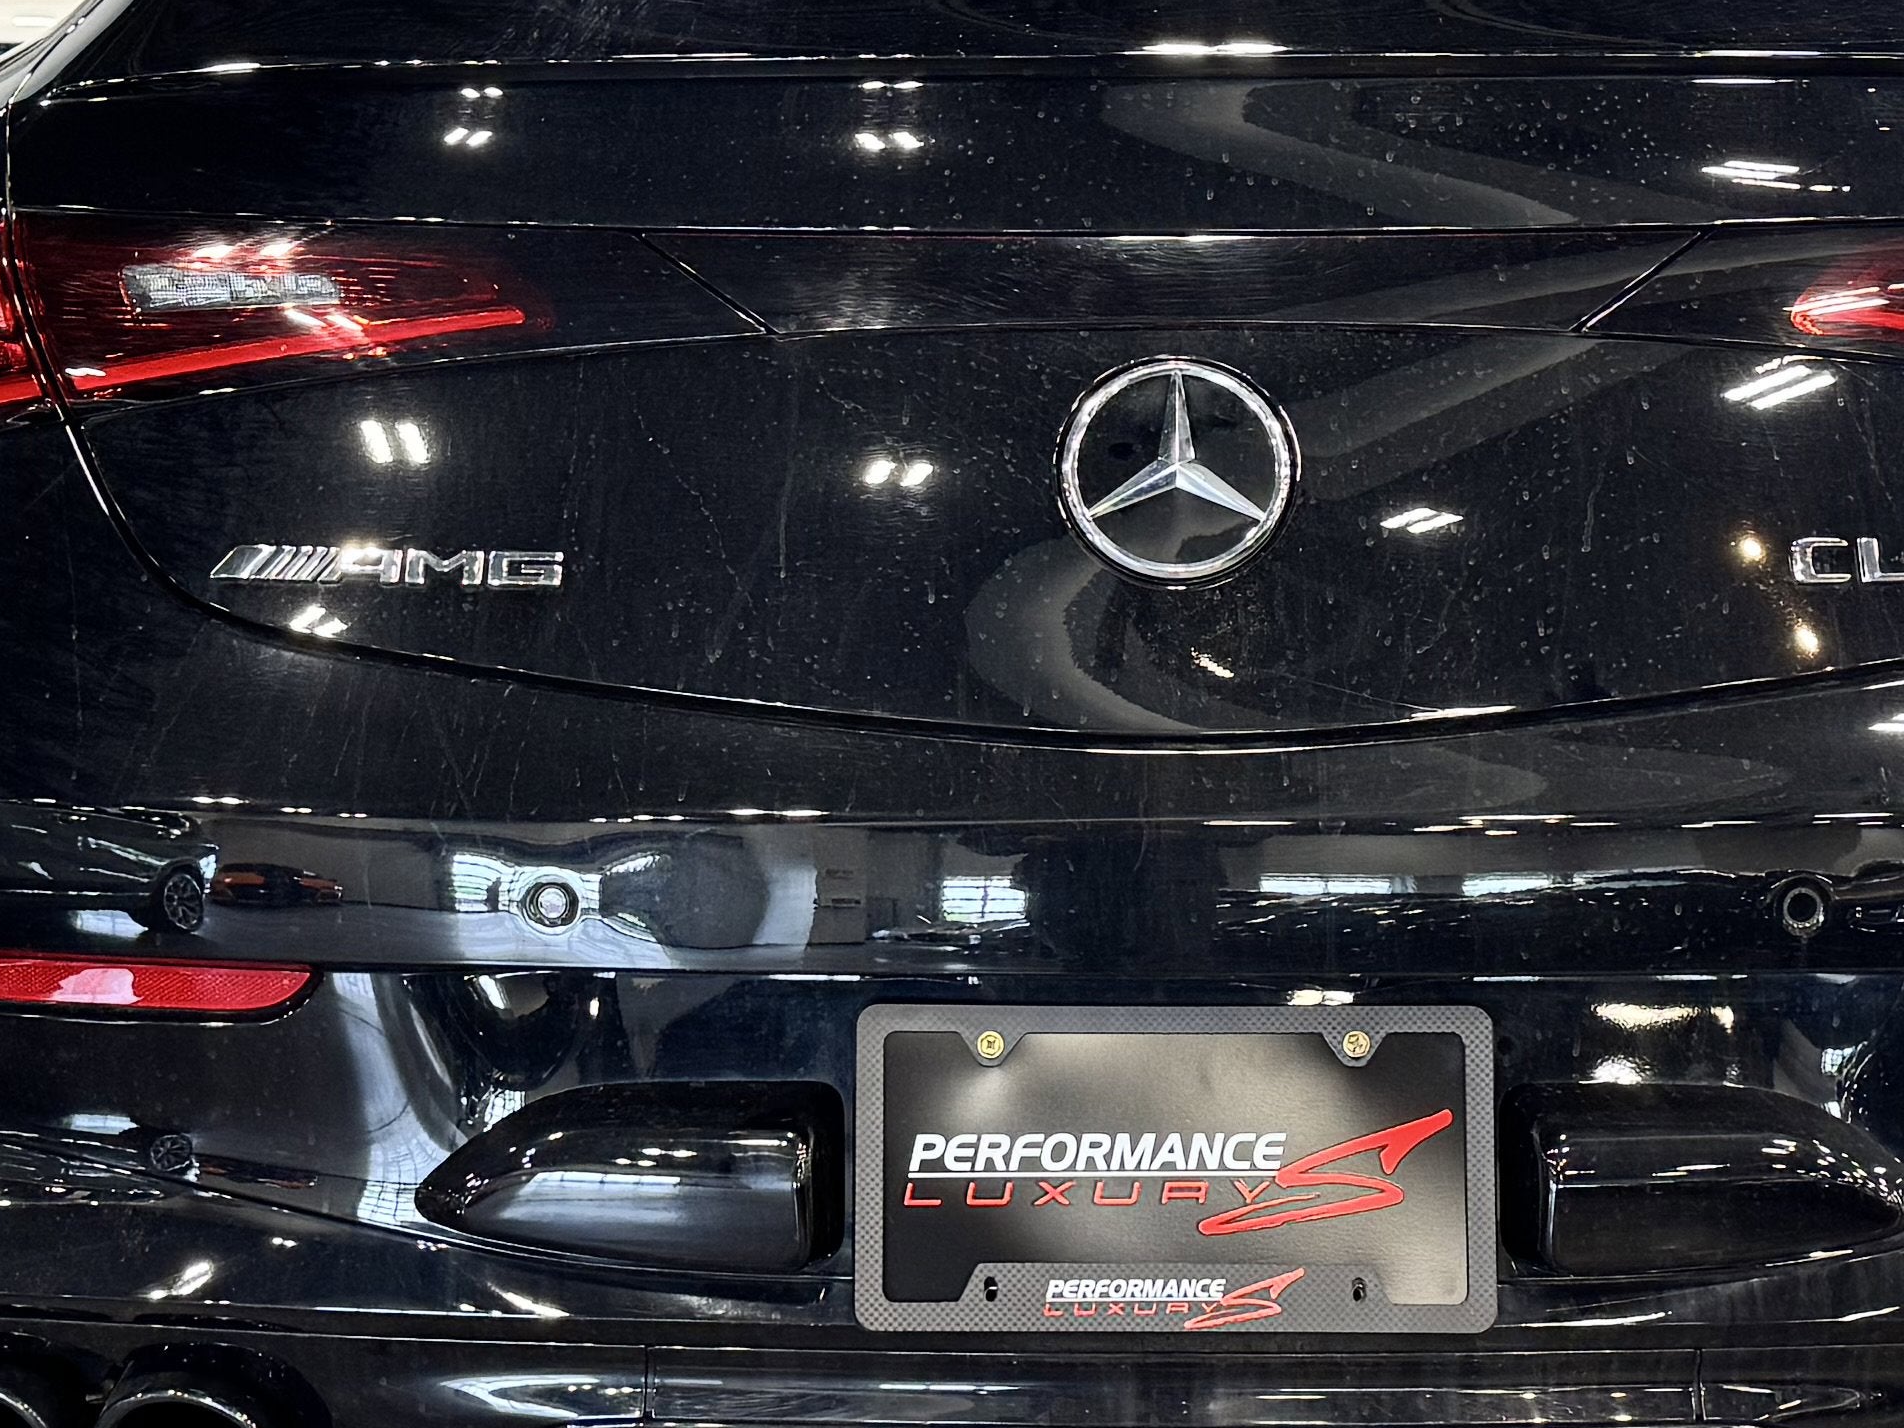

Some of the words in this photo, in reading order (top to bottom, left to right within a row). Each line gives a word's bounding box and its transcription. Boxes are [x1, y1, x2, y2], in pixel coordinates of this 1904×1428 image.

[908, 1132, 1286, 1172] PERFORMANCE
[903, 1179, 1270, 1206] LUXURY
[1046, 1278, 1226, 1298] PERFORMANCE
[1043, 1302, 1222, 1317] LUXURY
